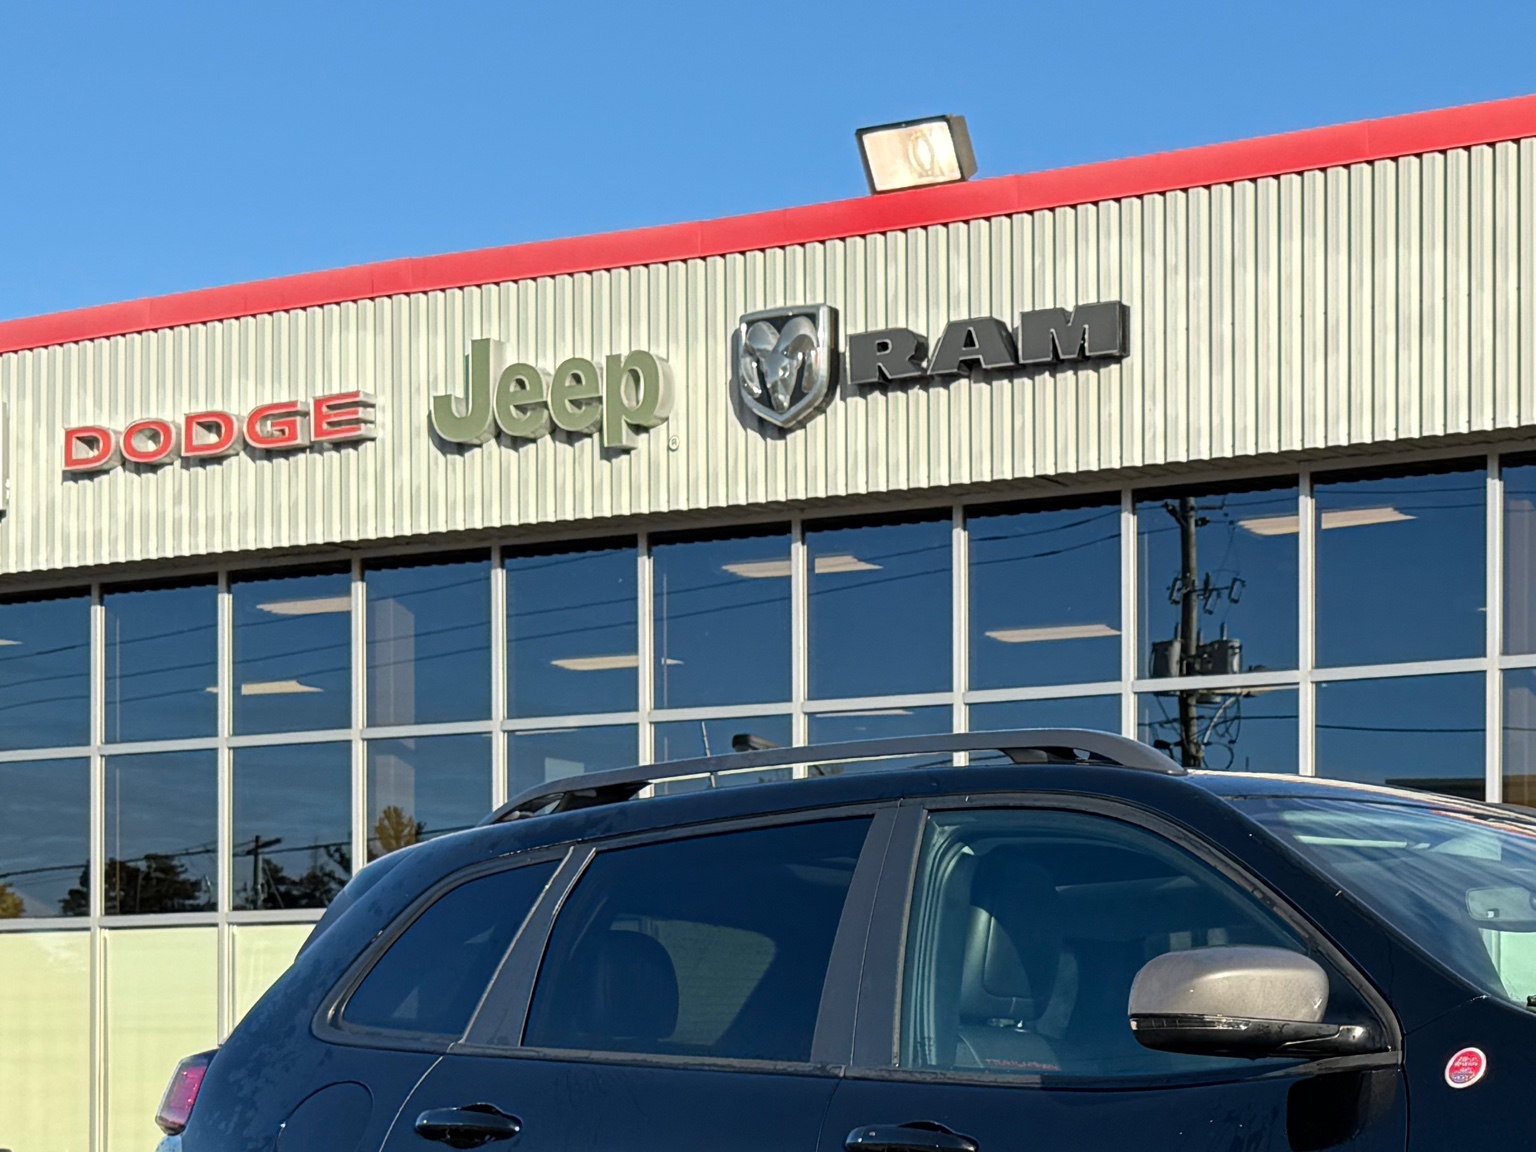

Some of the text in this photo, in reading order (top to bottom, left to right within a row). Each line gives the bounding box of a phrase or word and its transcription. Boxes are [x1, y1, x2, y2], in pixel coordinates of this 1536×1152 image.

[846, 300, 1130, 385] RAM
[63, 391, 377, 473] DODGE
[431, 337, 674, 450] Jeep
